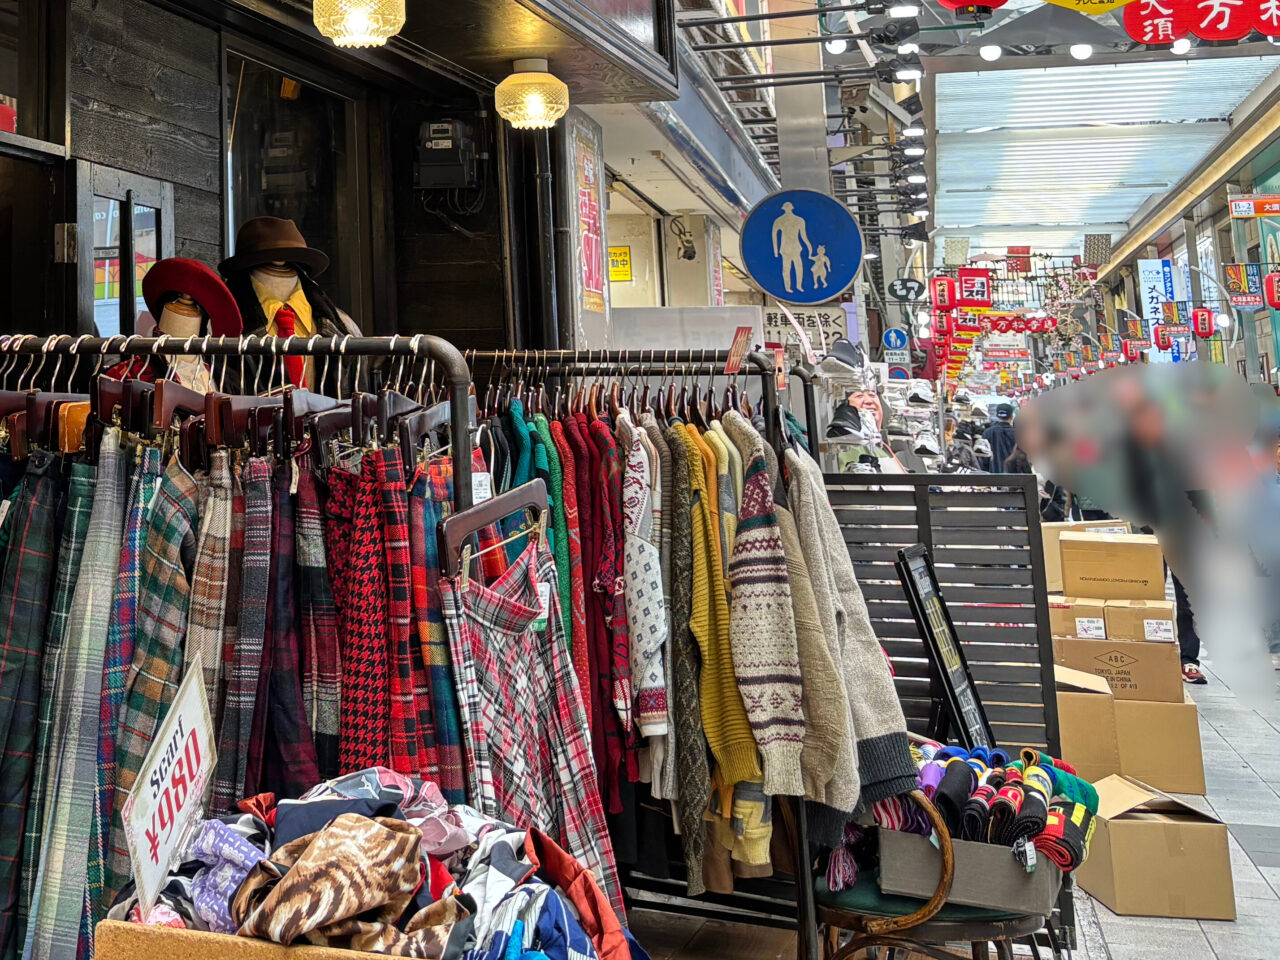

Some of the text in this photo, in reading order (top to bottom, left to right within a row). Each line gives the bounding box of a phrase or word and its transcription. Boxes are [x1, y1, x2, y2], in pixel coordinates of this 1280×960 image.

[893, 280, 919, 300] モア
[1108, 655, 1125, 663] ABC
[149, 713, 184, 800] Scarf
[145, 728, 201, 865] ¥980
